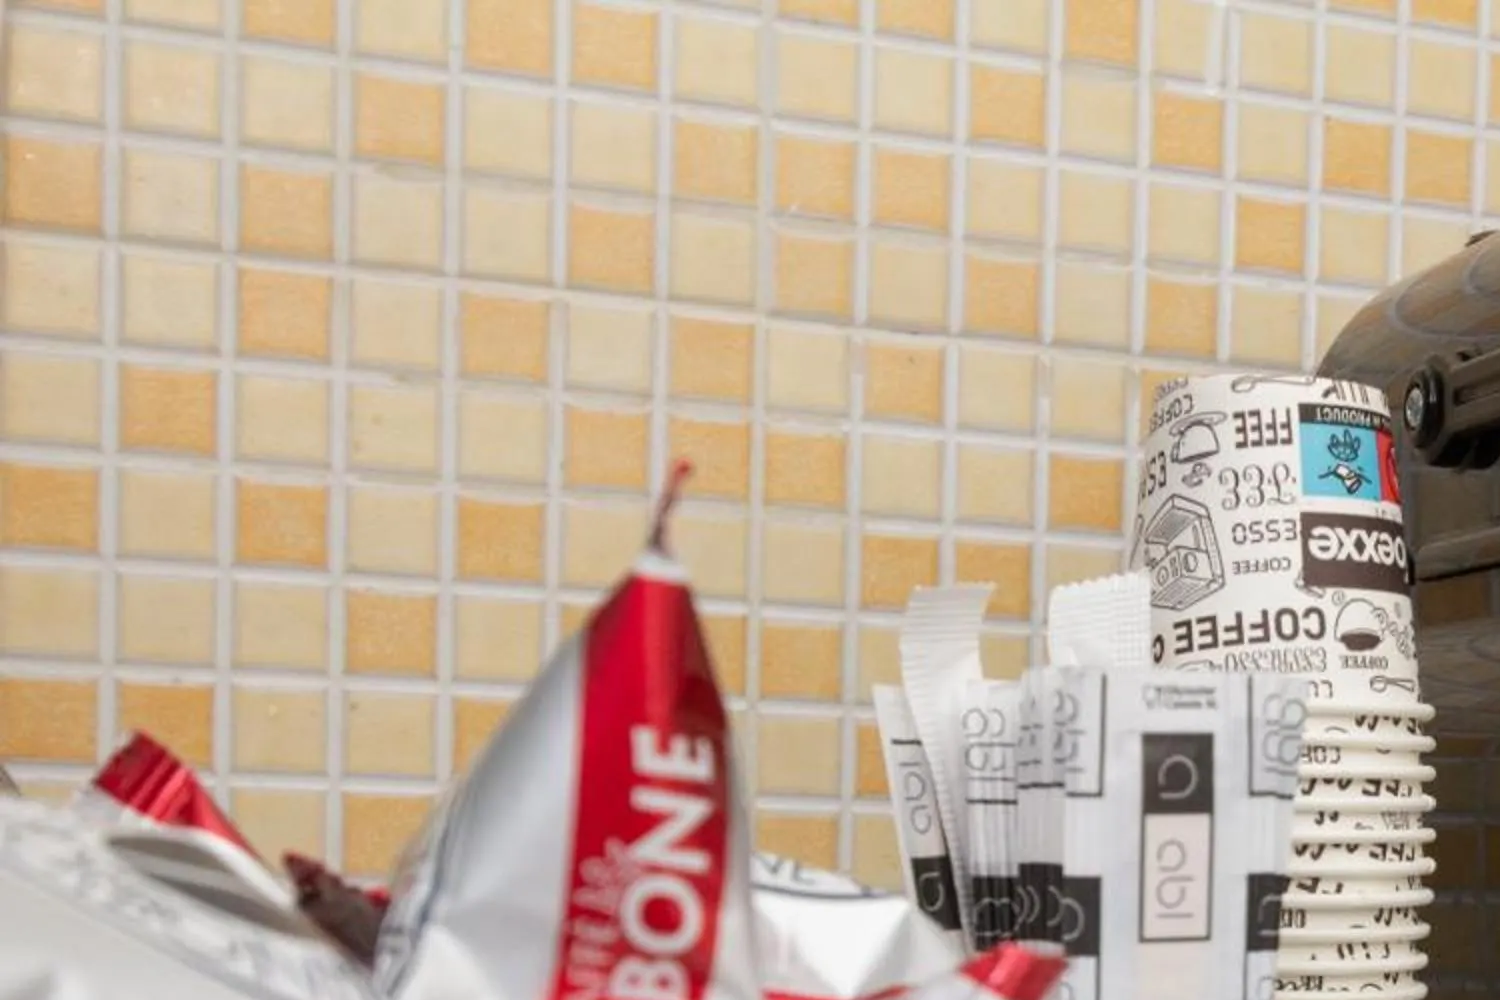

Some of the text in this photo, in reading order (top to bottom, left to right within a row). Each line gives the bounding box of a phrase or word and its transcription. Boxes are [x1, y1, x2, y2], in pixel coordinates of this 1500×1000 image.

[1231, 556, 1292, 576] COFFEE
[1172, 606, 1327, 656] COFFEE
[1339, 655, 1389, 671] COFFEE
